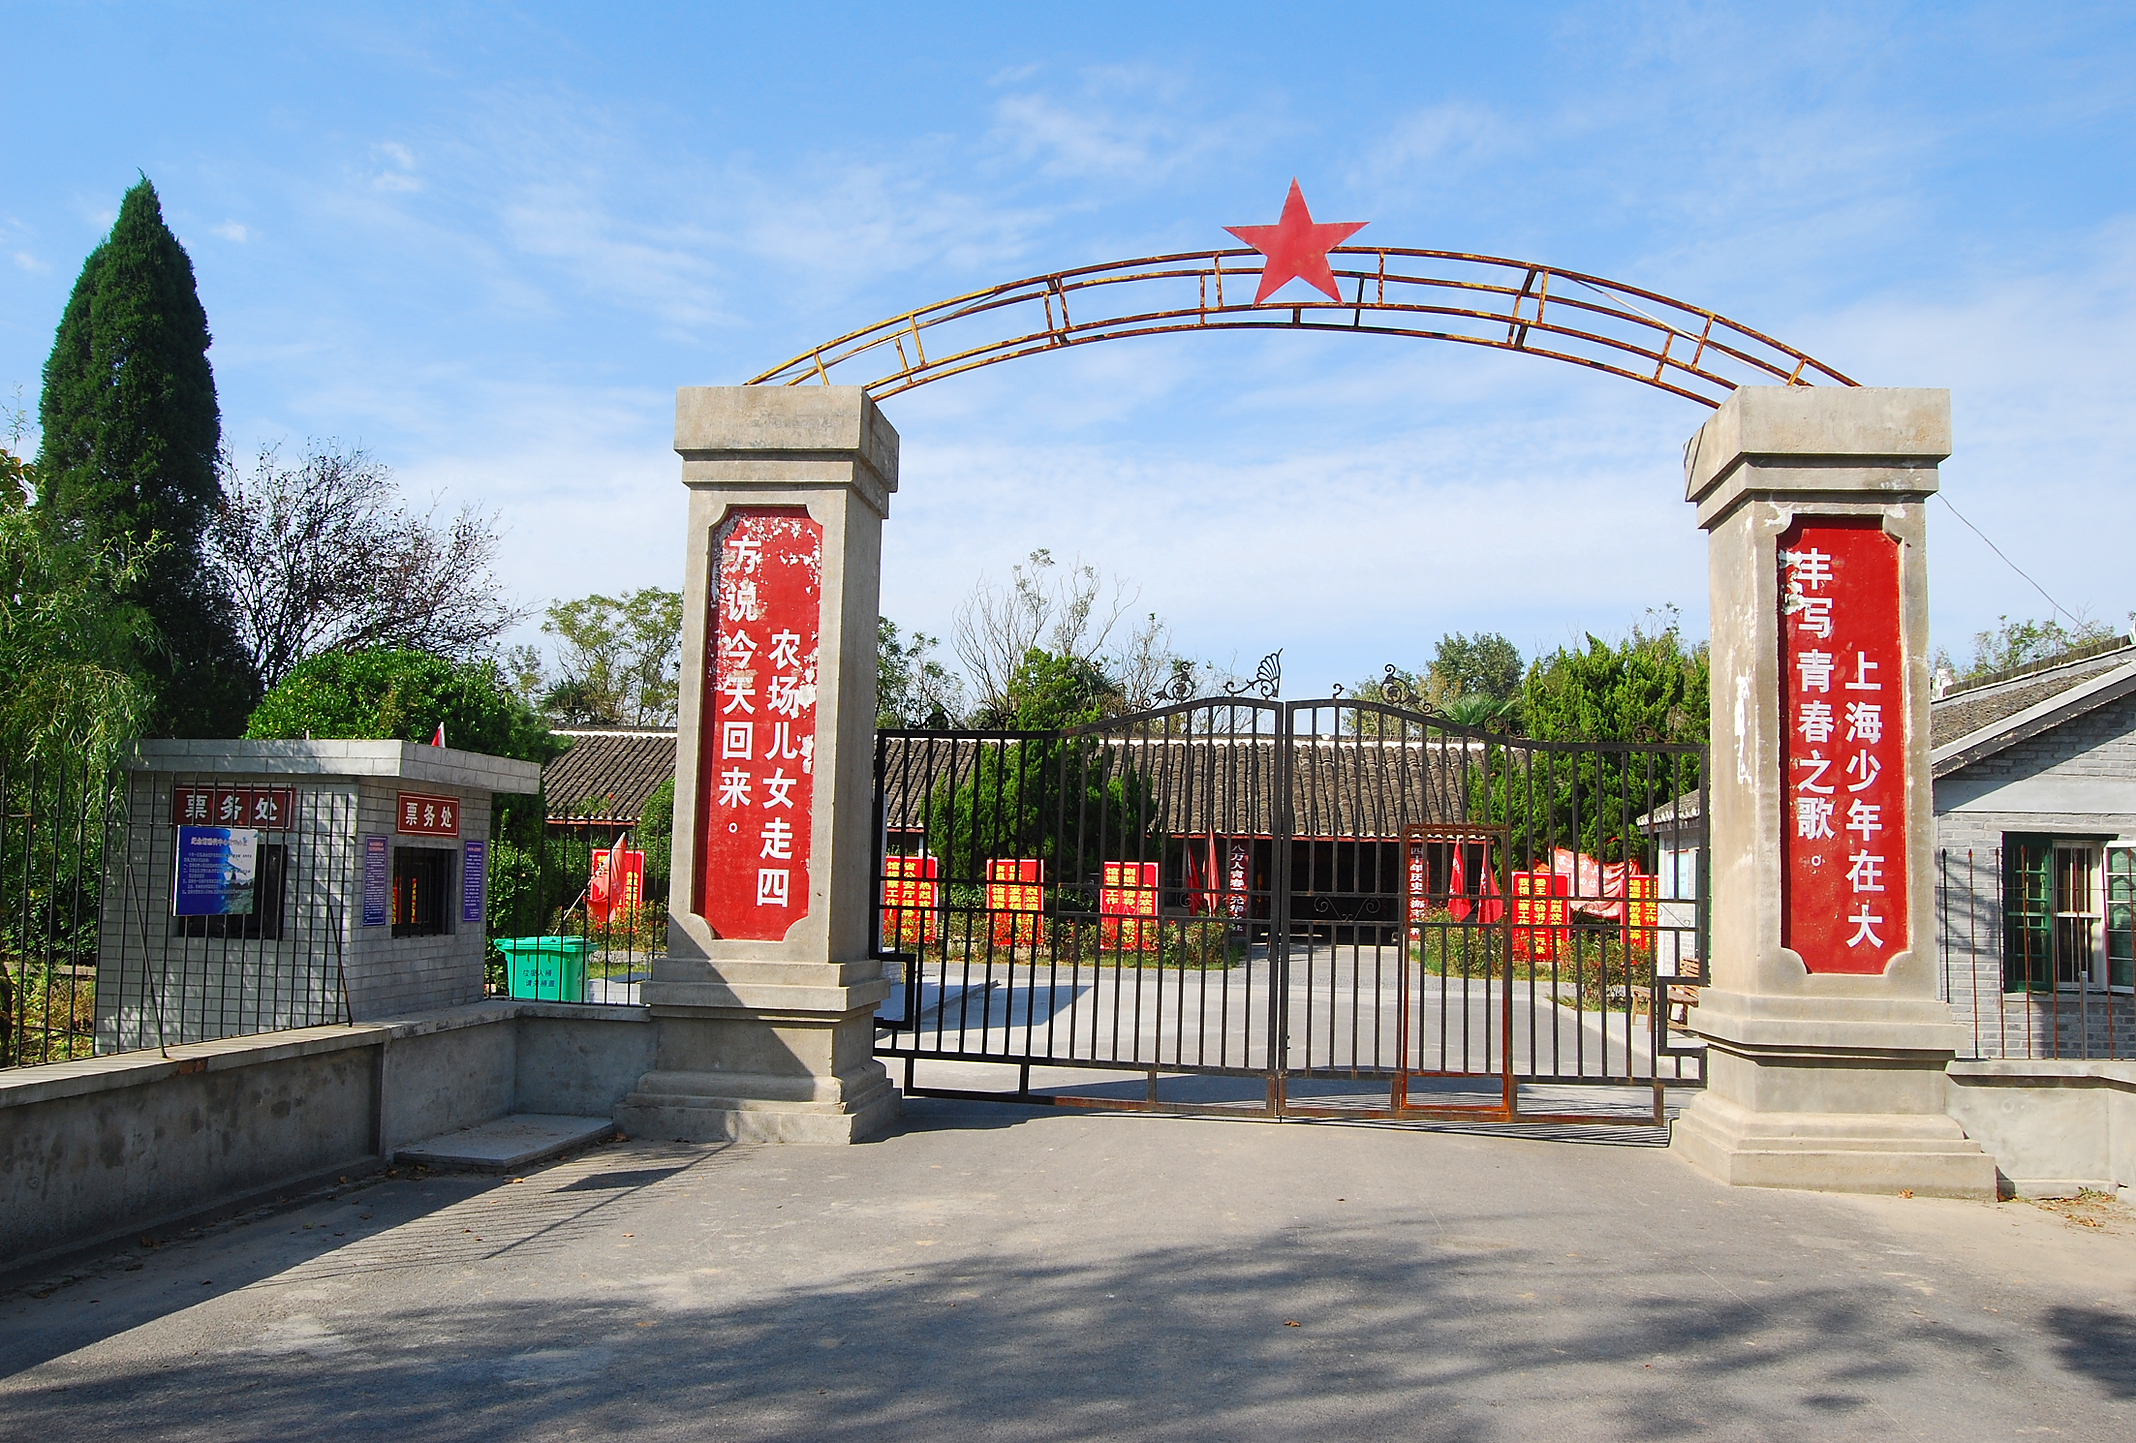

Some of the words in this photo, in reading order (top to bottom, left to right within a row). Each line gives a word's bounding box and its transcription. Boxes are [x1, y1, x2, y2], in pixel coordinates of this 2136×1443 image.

[184, 794, 278, 821] 票务处
[405, 801, 453, 829] 票务处
[755, 628, 801, 909] 农场儿女走四
[1844, 650, 1884, 949] 上海少年在大
